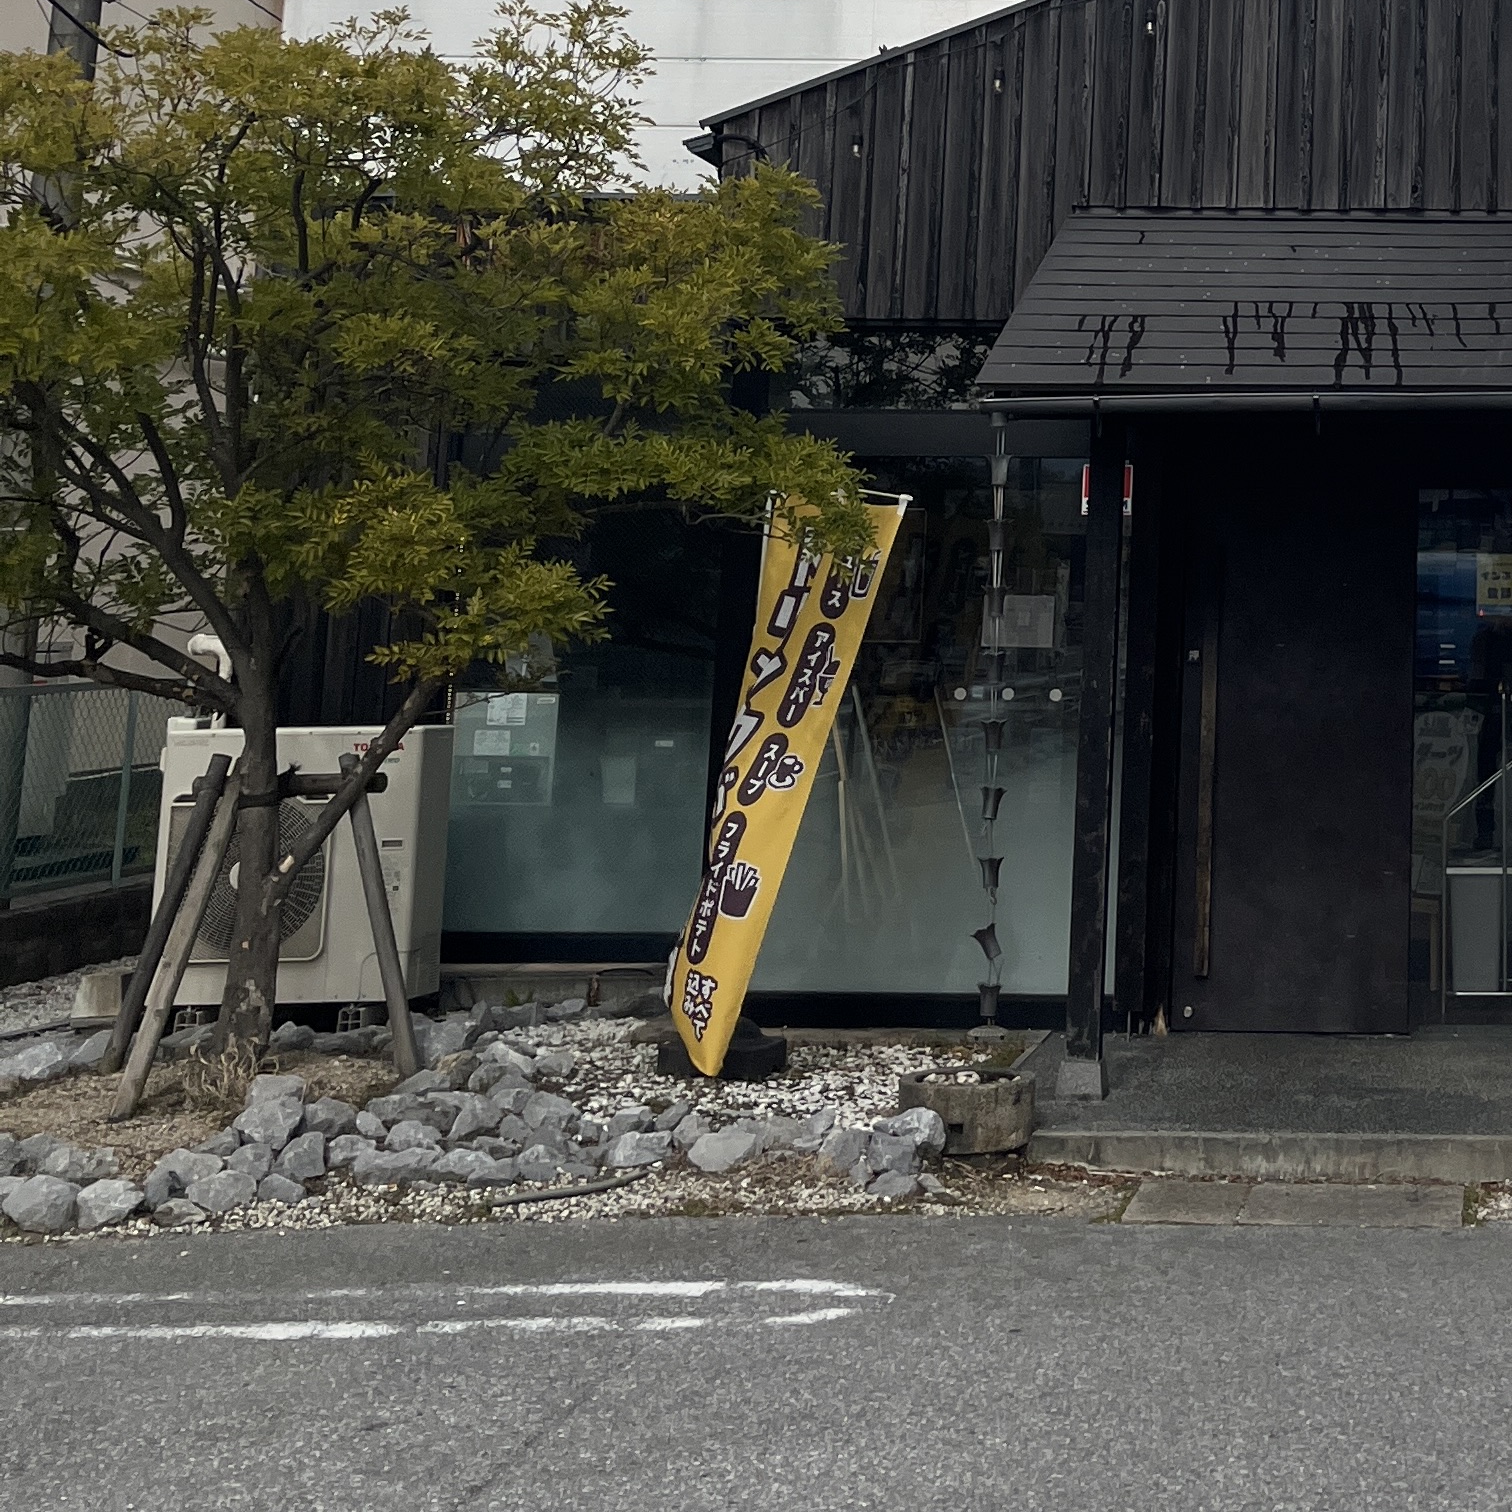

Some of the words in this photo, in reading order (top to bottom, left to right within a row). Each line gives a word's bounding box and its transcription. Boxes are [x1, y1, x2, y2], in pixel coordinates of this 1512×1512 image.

[690, 821, 739, 957] フライドポテト
